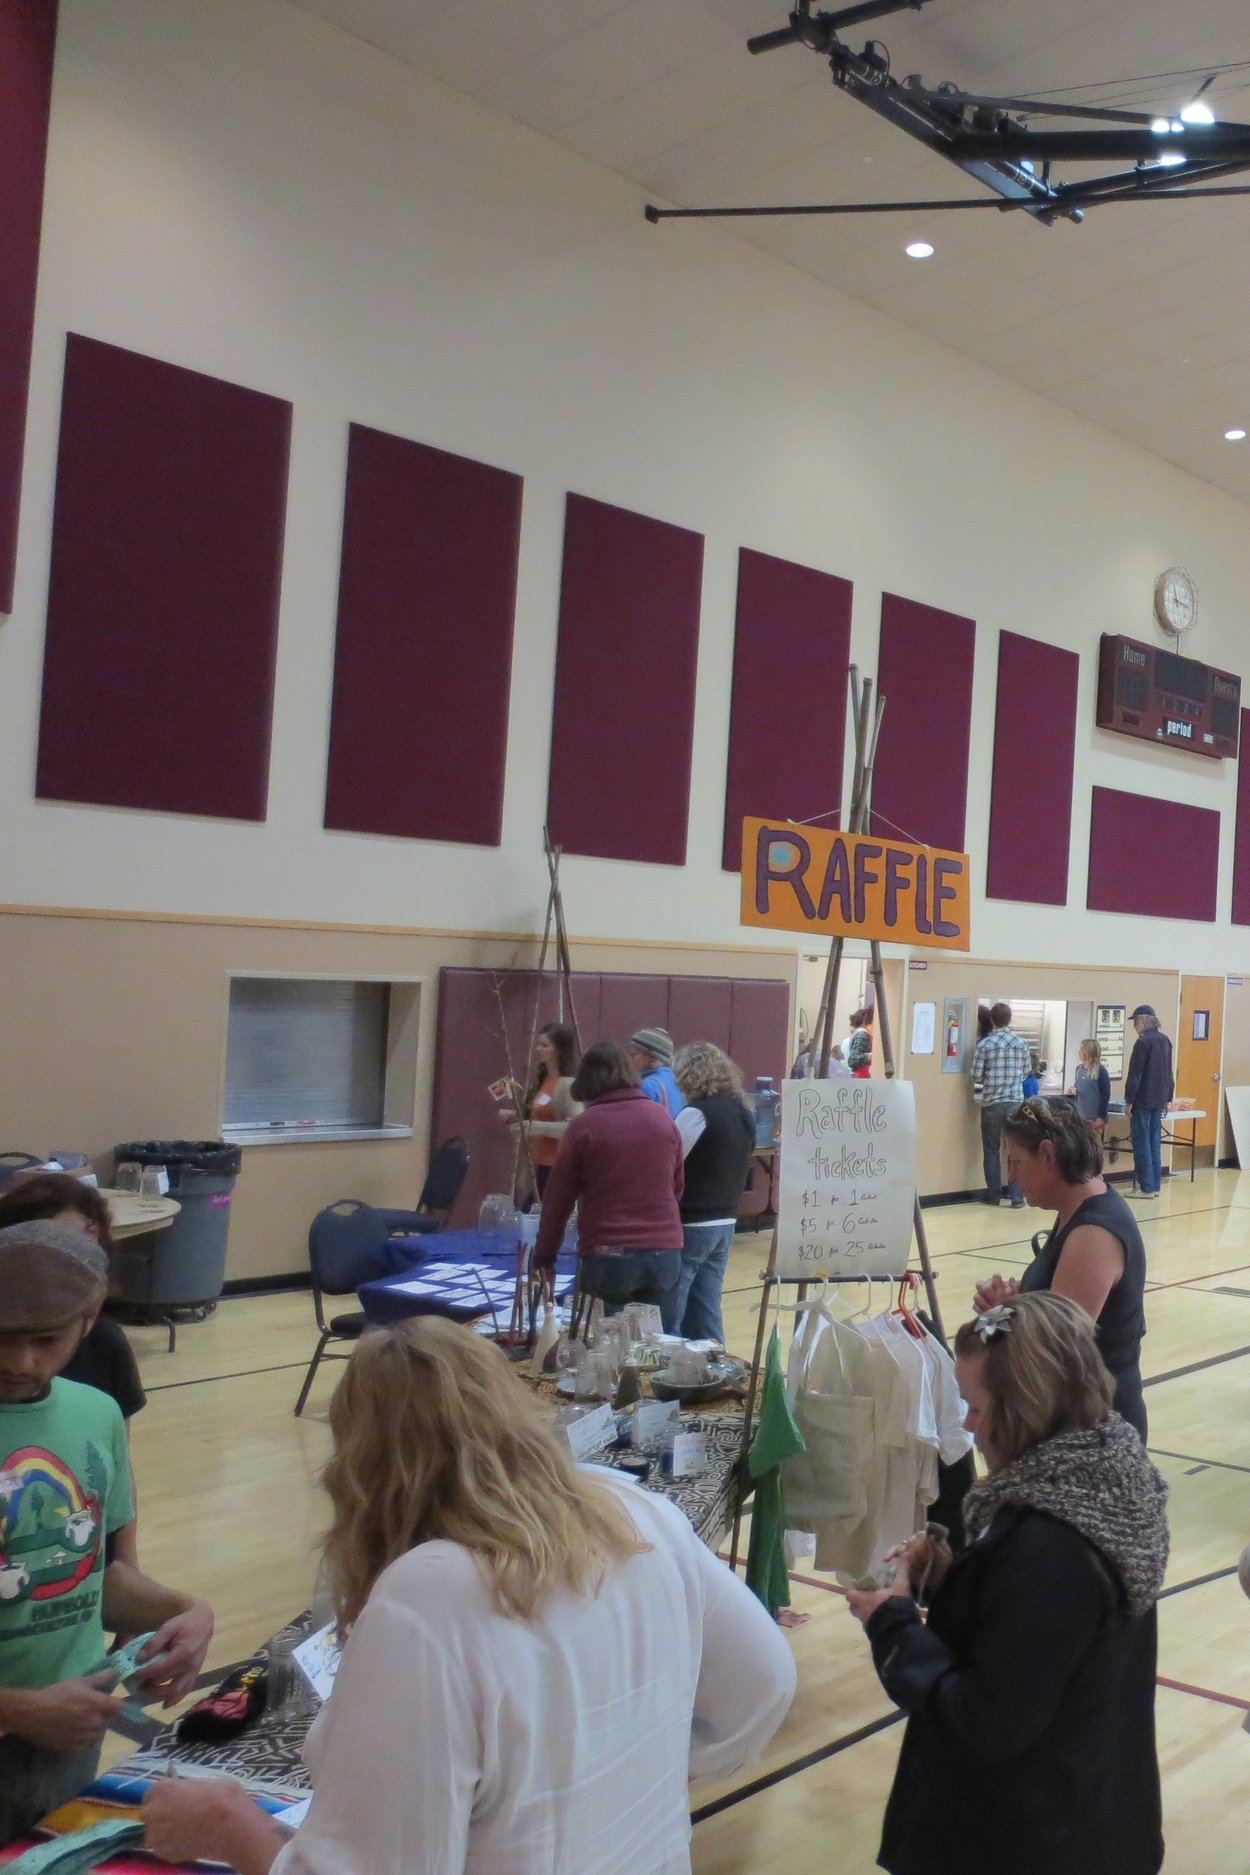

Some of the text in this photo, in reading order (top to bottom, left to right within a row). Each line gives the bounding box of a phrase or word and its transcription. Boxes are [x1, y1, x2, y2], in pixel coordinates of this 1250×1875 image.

[1123, 644, 1146, 666] Home
[1214, 676, 1238, 698] Guests
[1167, 720, 1192, 738] period
[755, 825, 963, 937] RAFFLE
[795, 1087, 888, 1139] Raffle
[807, 1142, 888, 1180] tickets
[802, 1189, 822, 1208] $1
[849, 1189, 859, 1207] 1
[800, 1217, 817, 1236] $5
[842, 1212, 857, 1234] 6
[798, 1244, 824, 1261] $20
[844, 1240, 865, 1258] 25
